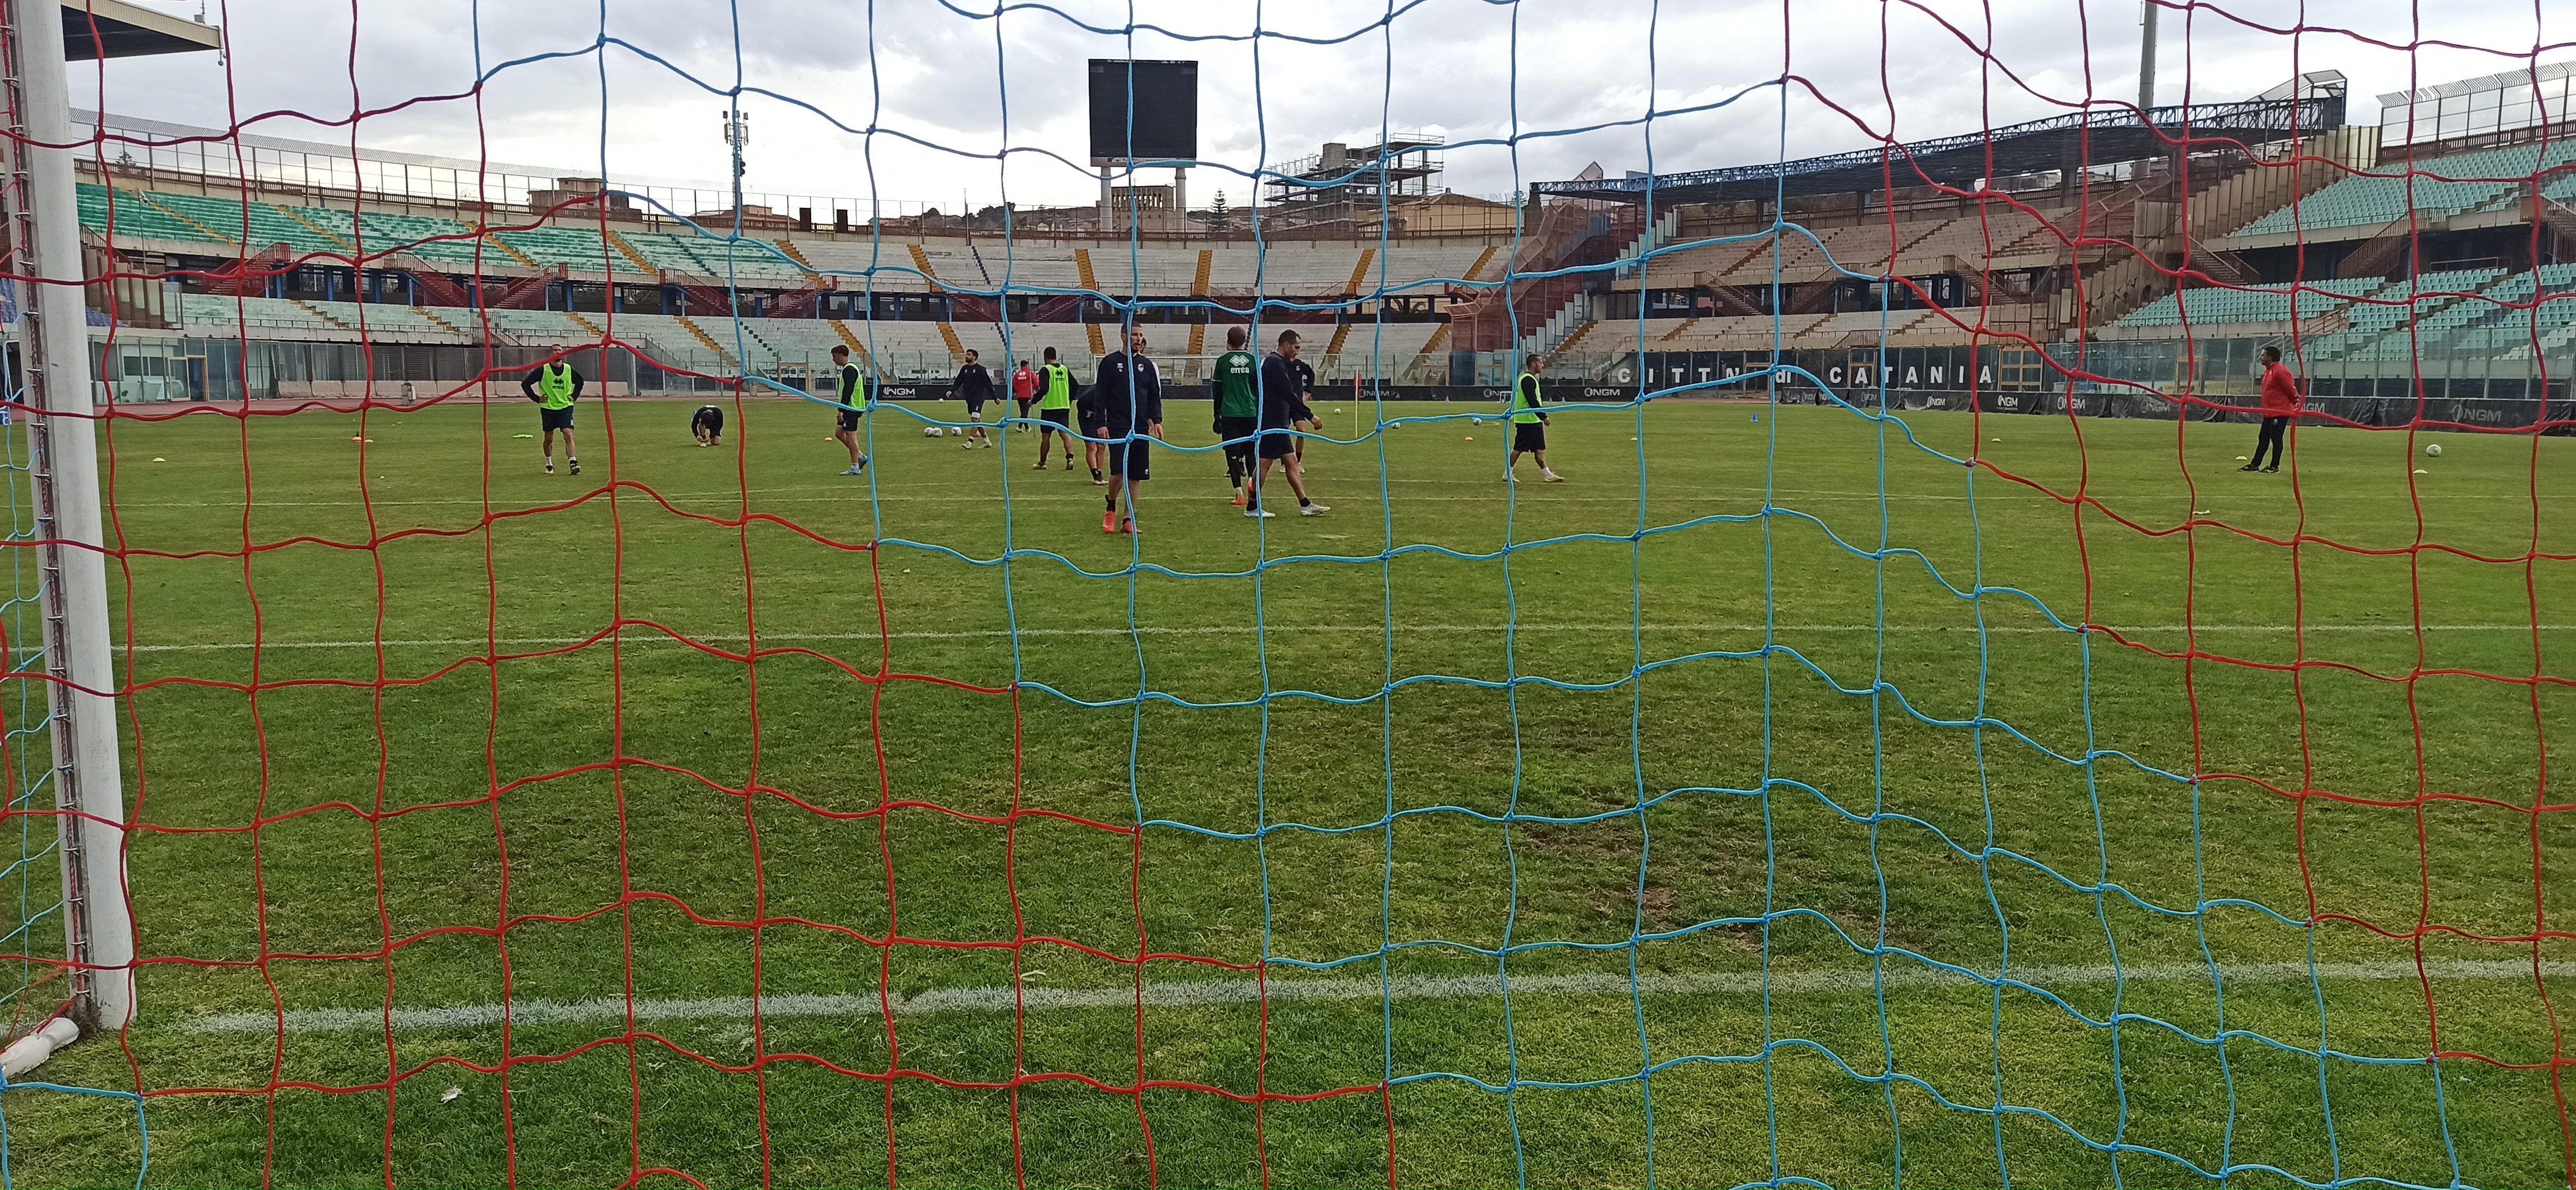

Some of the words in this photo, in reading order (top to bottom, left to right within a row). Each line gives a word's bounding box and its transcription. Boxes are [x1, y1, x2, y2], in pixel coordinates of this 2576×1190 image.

[1829, 365, 1992, 384] CATANIA
[2001, 397, 2018, 407] NGM
[2462, 408, 2502, 422] NGM
